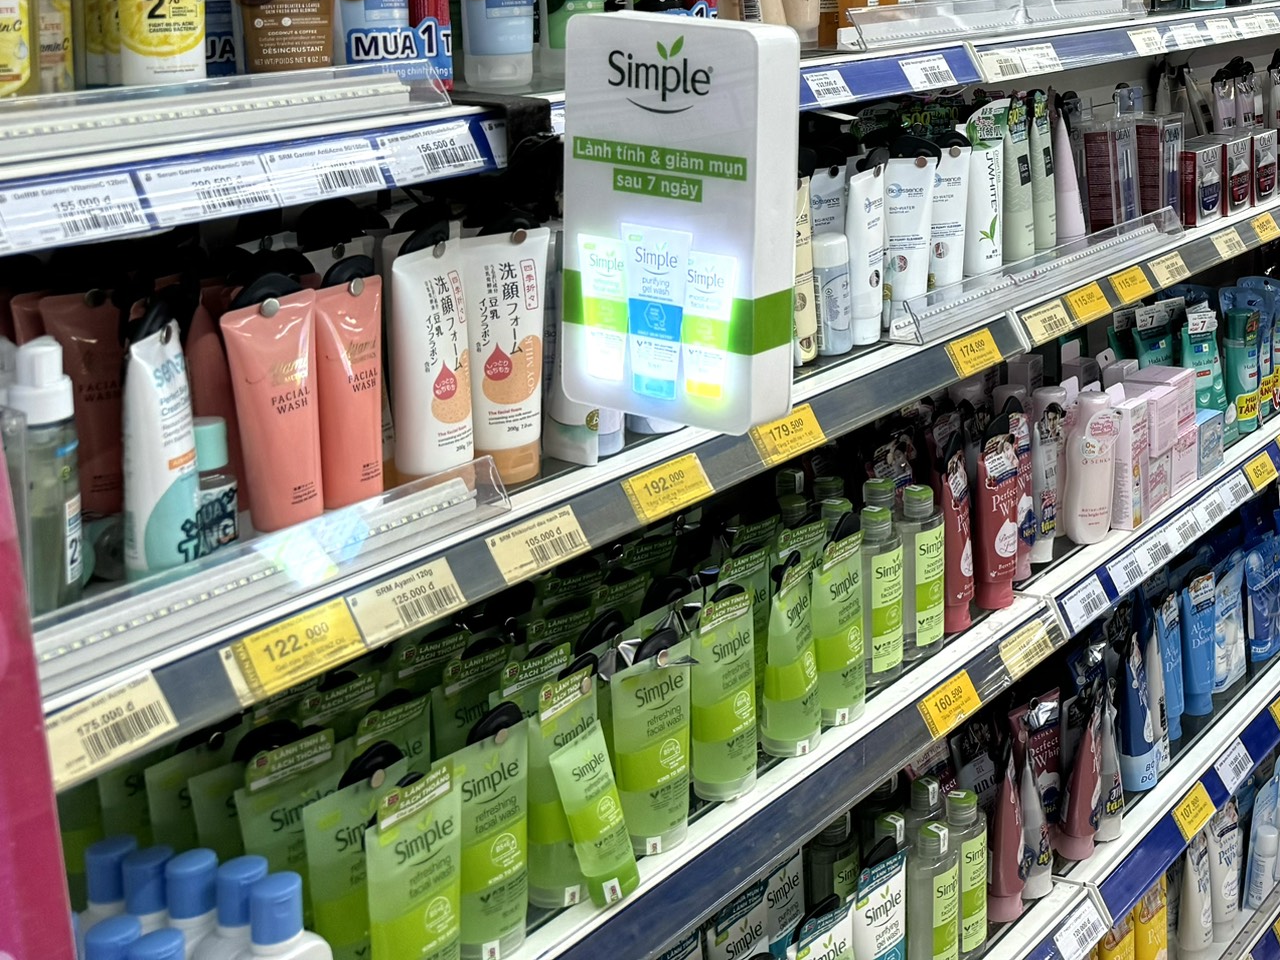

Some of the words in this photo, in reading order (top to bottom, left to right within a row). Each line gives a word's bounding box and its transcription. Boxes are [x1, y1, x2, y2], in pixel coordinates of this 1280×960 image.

[262, 45, 324, 54] DÉSINCRUSTANT
[354, 30, 415, 57] MUA
[419, 23, 434, 54] 1
[608, 50, 711, 102] Simple
[416, 140, 448, 154] 156.500
[576, 141, 612, 159] Lành
[616, 145, 645, 163] tính
[651, 149, 660, 165] &
[665, 152, 704, 170] giảm
[709, 159, 743, 177] mụn
[617, 174, 642, 189] sau
[647, 176, 657, 190] 7
[661, 179, 698, 198] ngày
[635, 246, 678, 270] Simple
[498, 262, 524, 355] 洗顔フォーム
[525, 336, 534, 368] MILK
[348, 368, 378, 384] FACIAL
[352, 379, 377, 393] WASH
[526, 369, 536, 394] SOY
[271, 386, 311, 406] FACIAL
[276, 397, 308, 415] WASH
[768, 418, 805, 442] 179.500
[643, 469, 685, 497] 192.000
[524, 529, 556, 548] 105.000
[375, 585, 394, 597] SRM
[394, 575, 416, 591] Ayami
[416, 568, 434, 581] 120g
[391, 586, 427, 606] 125.000
[830, 571, 860, 604] Simple
[263, 622, 330, 663] 122.000
[711, 630, 751, 663] Simple
[634, 673, 685, 708] Simple
[933, 686, 964, 713] 160.500
[646, 722, 666, 737] facial
[666, 713, 685, 728] wash
[647, 704, 682, 726] refreshing
[461, 759, 520, 803] Simple
[572, 752, 606, 782] Simple
[474, 815, 497, 835] facial
[498, 804, 520, 823] wash
[475, 795, 517, 823] refreshing
[394, 818, 454, 866] Simple
[409, 855, 452, 885] refreshing
[767, 874, 801, 909] Simple
[865, 895, 902, 927] Simple
[875, 920, 900, 941] purifying
[875, 938, 886, 951] gel
[886, 929, 902, 945] wash
